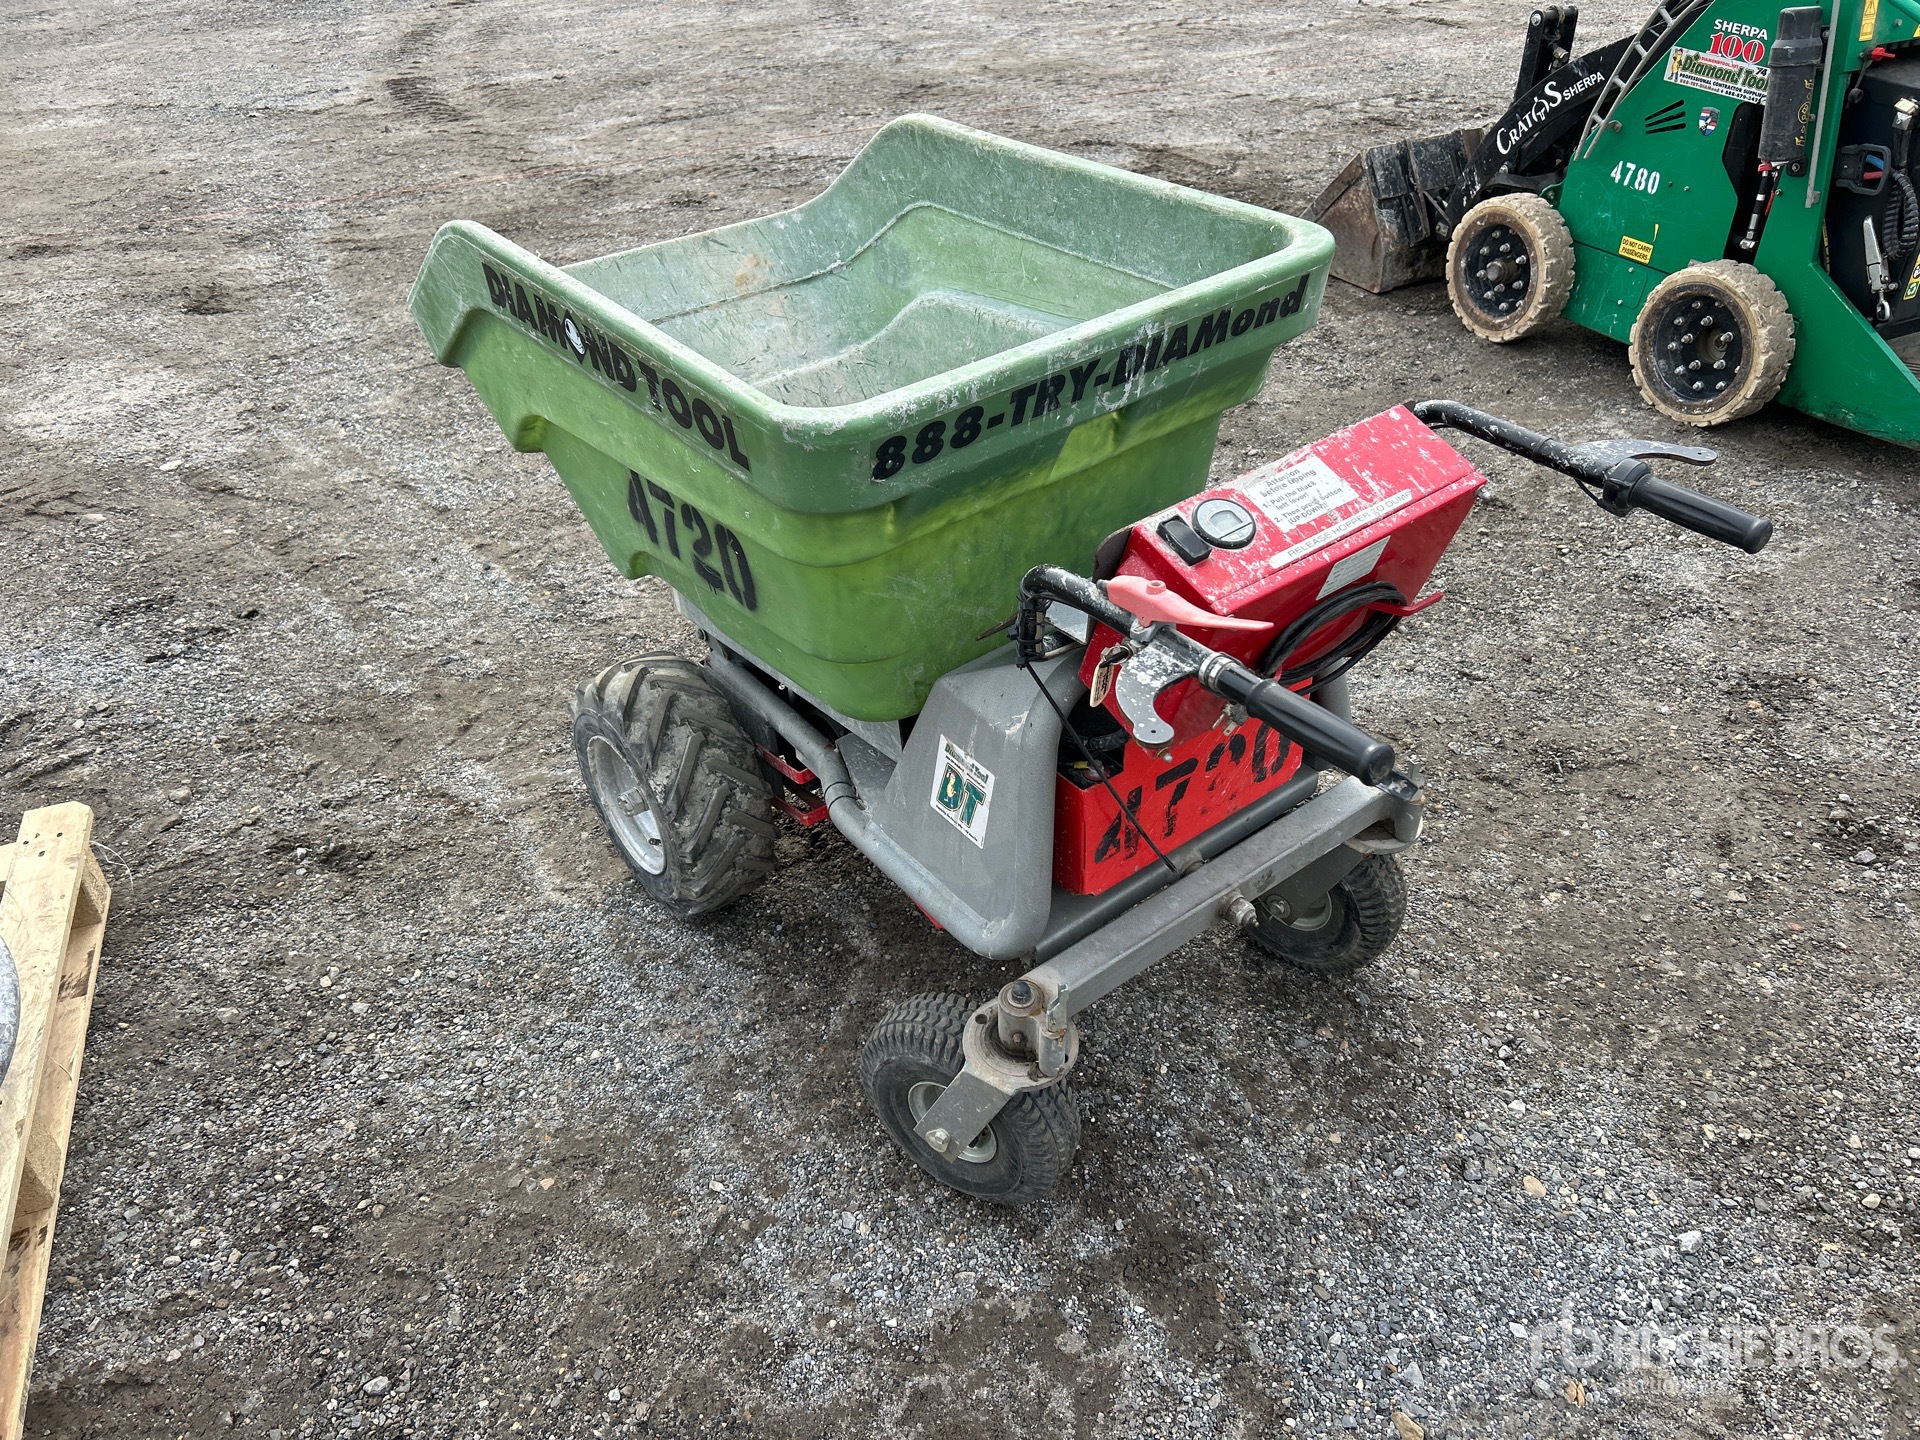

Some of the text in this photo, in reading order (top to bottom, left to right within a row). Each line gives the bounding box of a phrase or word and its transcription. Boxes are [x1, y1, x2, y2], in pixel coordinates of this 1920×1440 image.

[1713, 19, 1768, 40] SHERPA
[1706, 32, 1765, 65] 100
[1680, 72, 1712, 86] PROFESSIONAL
[1712, 80, 1743, 93] CONTRACTOR
[1682, 52, 1744, 85] Diamond
[1563, 71, 1605, 101] SHERPA
[1610, 160, 1661, 194] 4780
[1622, 246, 1648, 260] PASSENGERS
[1638, 243, 1652, 253] CARRY
[481, 262, 751, 471] DIAMOND TOOL
[871, 273, 1311, 483] 888-TRY-DIAMond
[1259, 469, 1317, 498] before tipping
[1270, 494, 1285, 505] Pull
[1285, 490, 1297, 499] the
[1298, 481, 1317, 494] black
[1275, 500, 1289, 511] left
[1282, 508, 1300, 519] Then
[1287, 490, 1412, 557] RELEASE HOPPER TO DUMP
[628, 468, 758, 611] 4720
